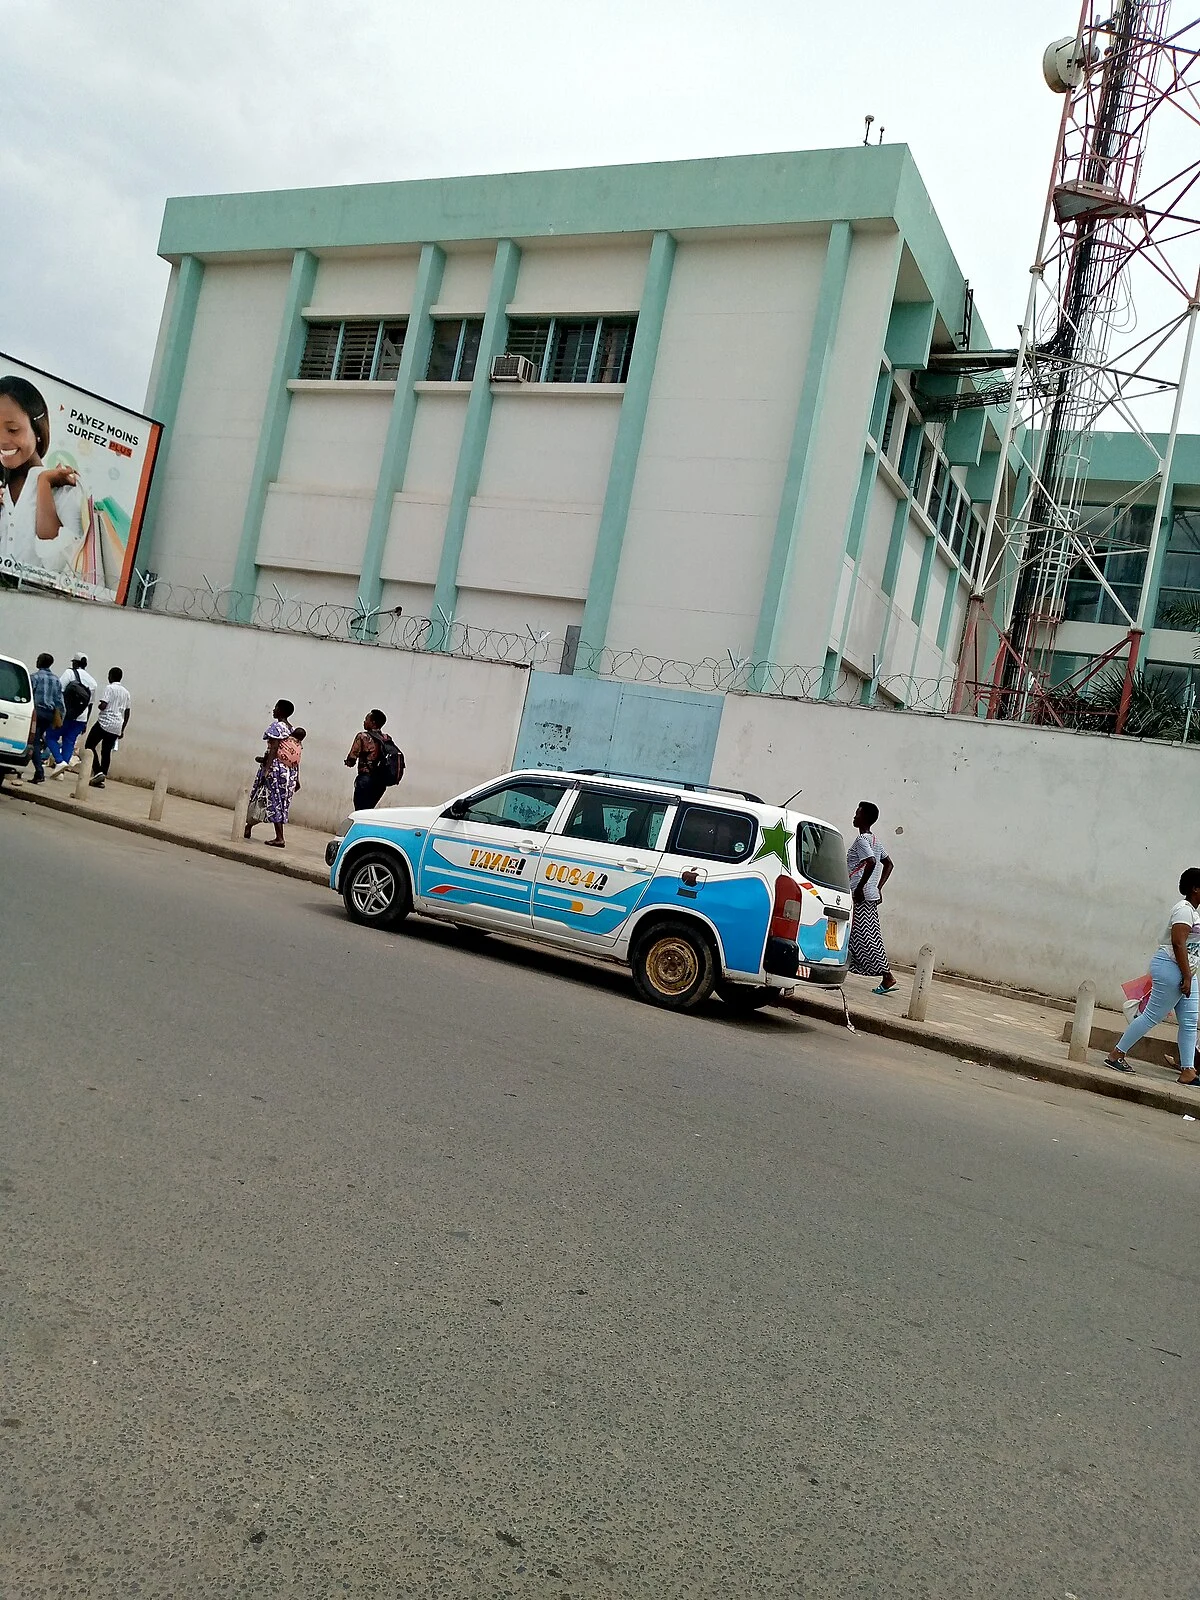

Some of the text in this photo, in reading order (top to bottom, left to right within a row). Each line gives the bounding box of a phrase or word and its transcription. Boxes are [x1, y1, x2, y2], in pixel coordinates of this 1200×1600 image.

[66, 423, 132, 457] SURFEZ PLUS
[70, 409, 139, 446] PAYEZ MOINS
